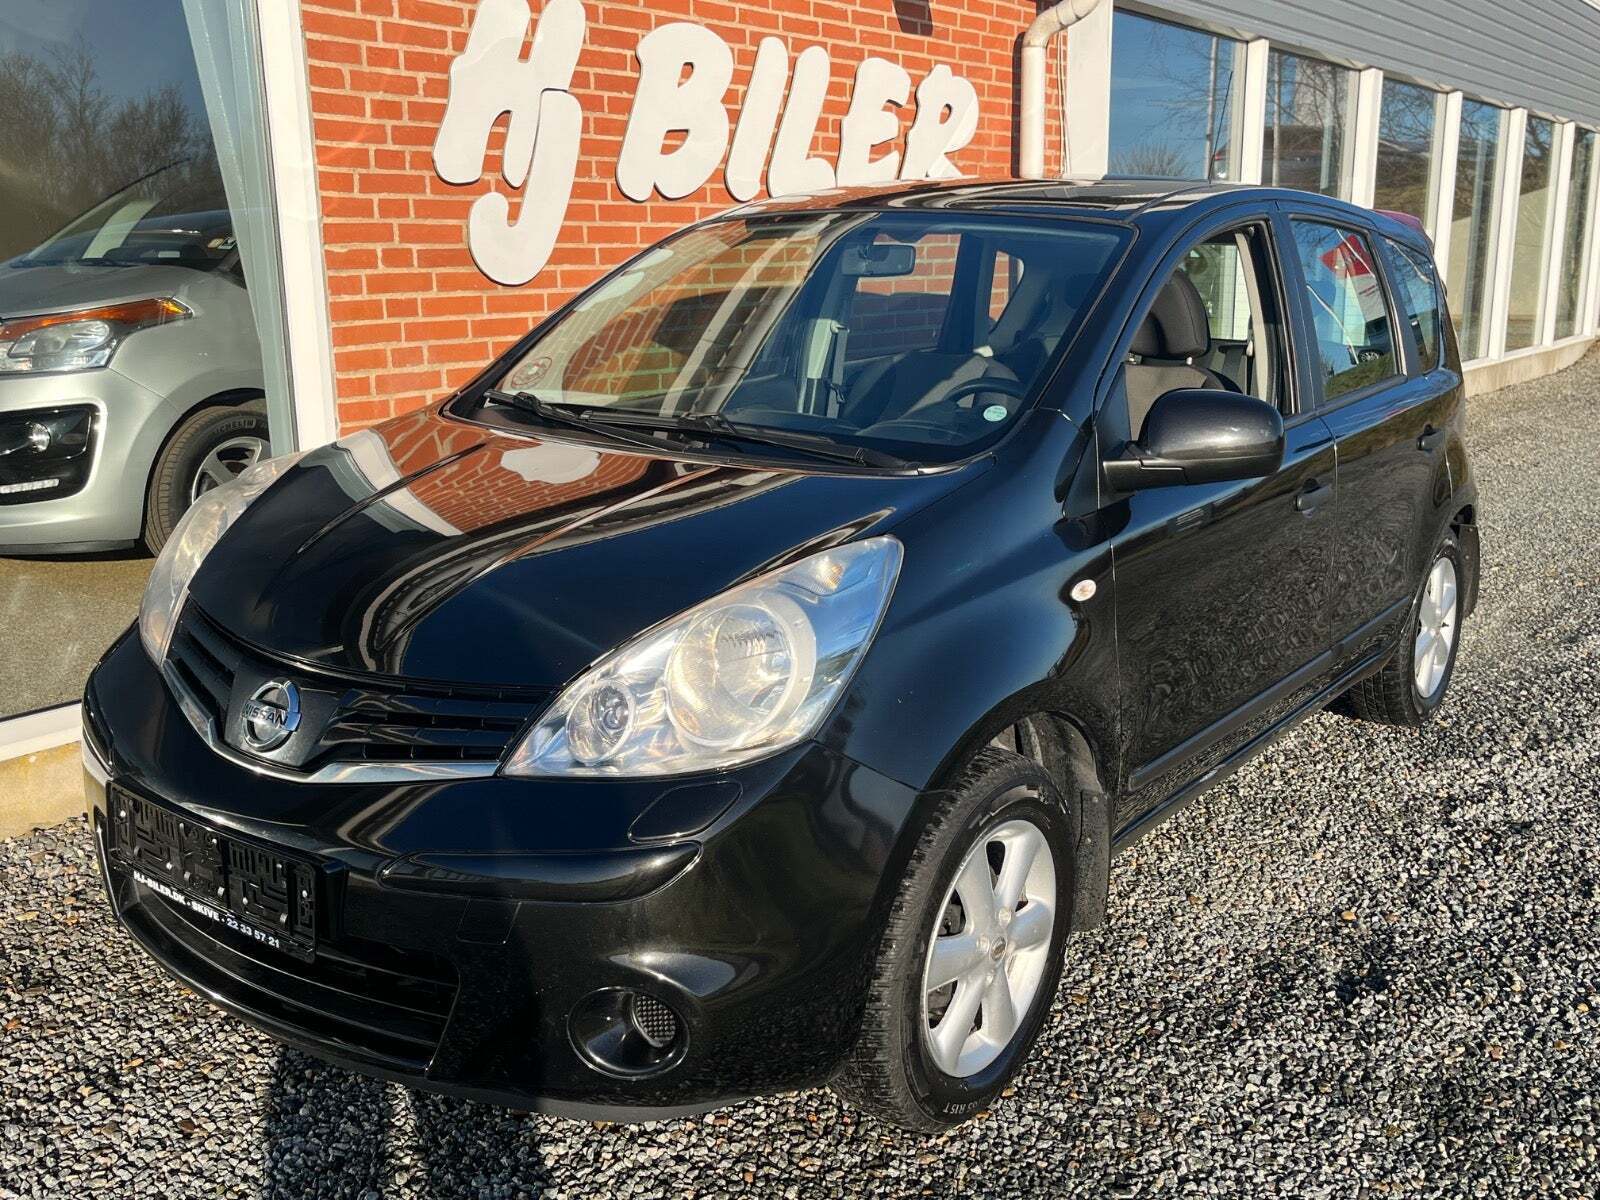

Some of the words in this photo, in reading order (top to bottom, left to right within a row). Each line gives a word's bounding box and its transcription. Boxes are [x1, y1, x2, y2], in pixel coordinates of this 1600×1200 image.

[433, 0, 586, 285] HJ
[616, 22, 980, 202] BILER
[242, 703, 289, 725] NISSAN
[192, 901, 220, 922] SKIVE
[226, 917, 239, 930] 22
[240, 924, 252, 936] 33
[254, 929, 267, 942] 57
[268, 936, 280, 949] 21
